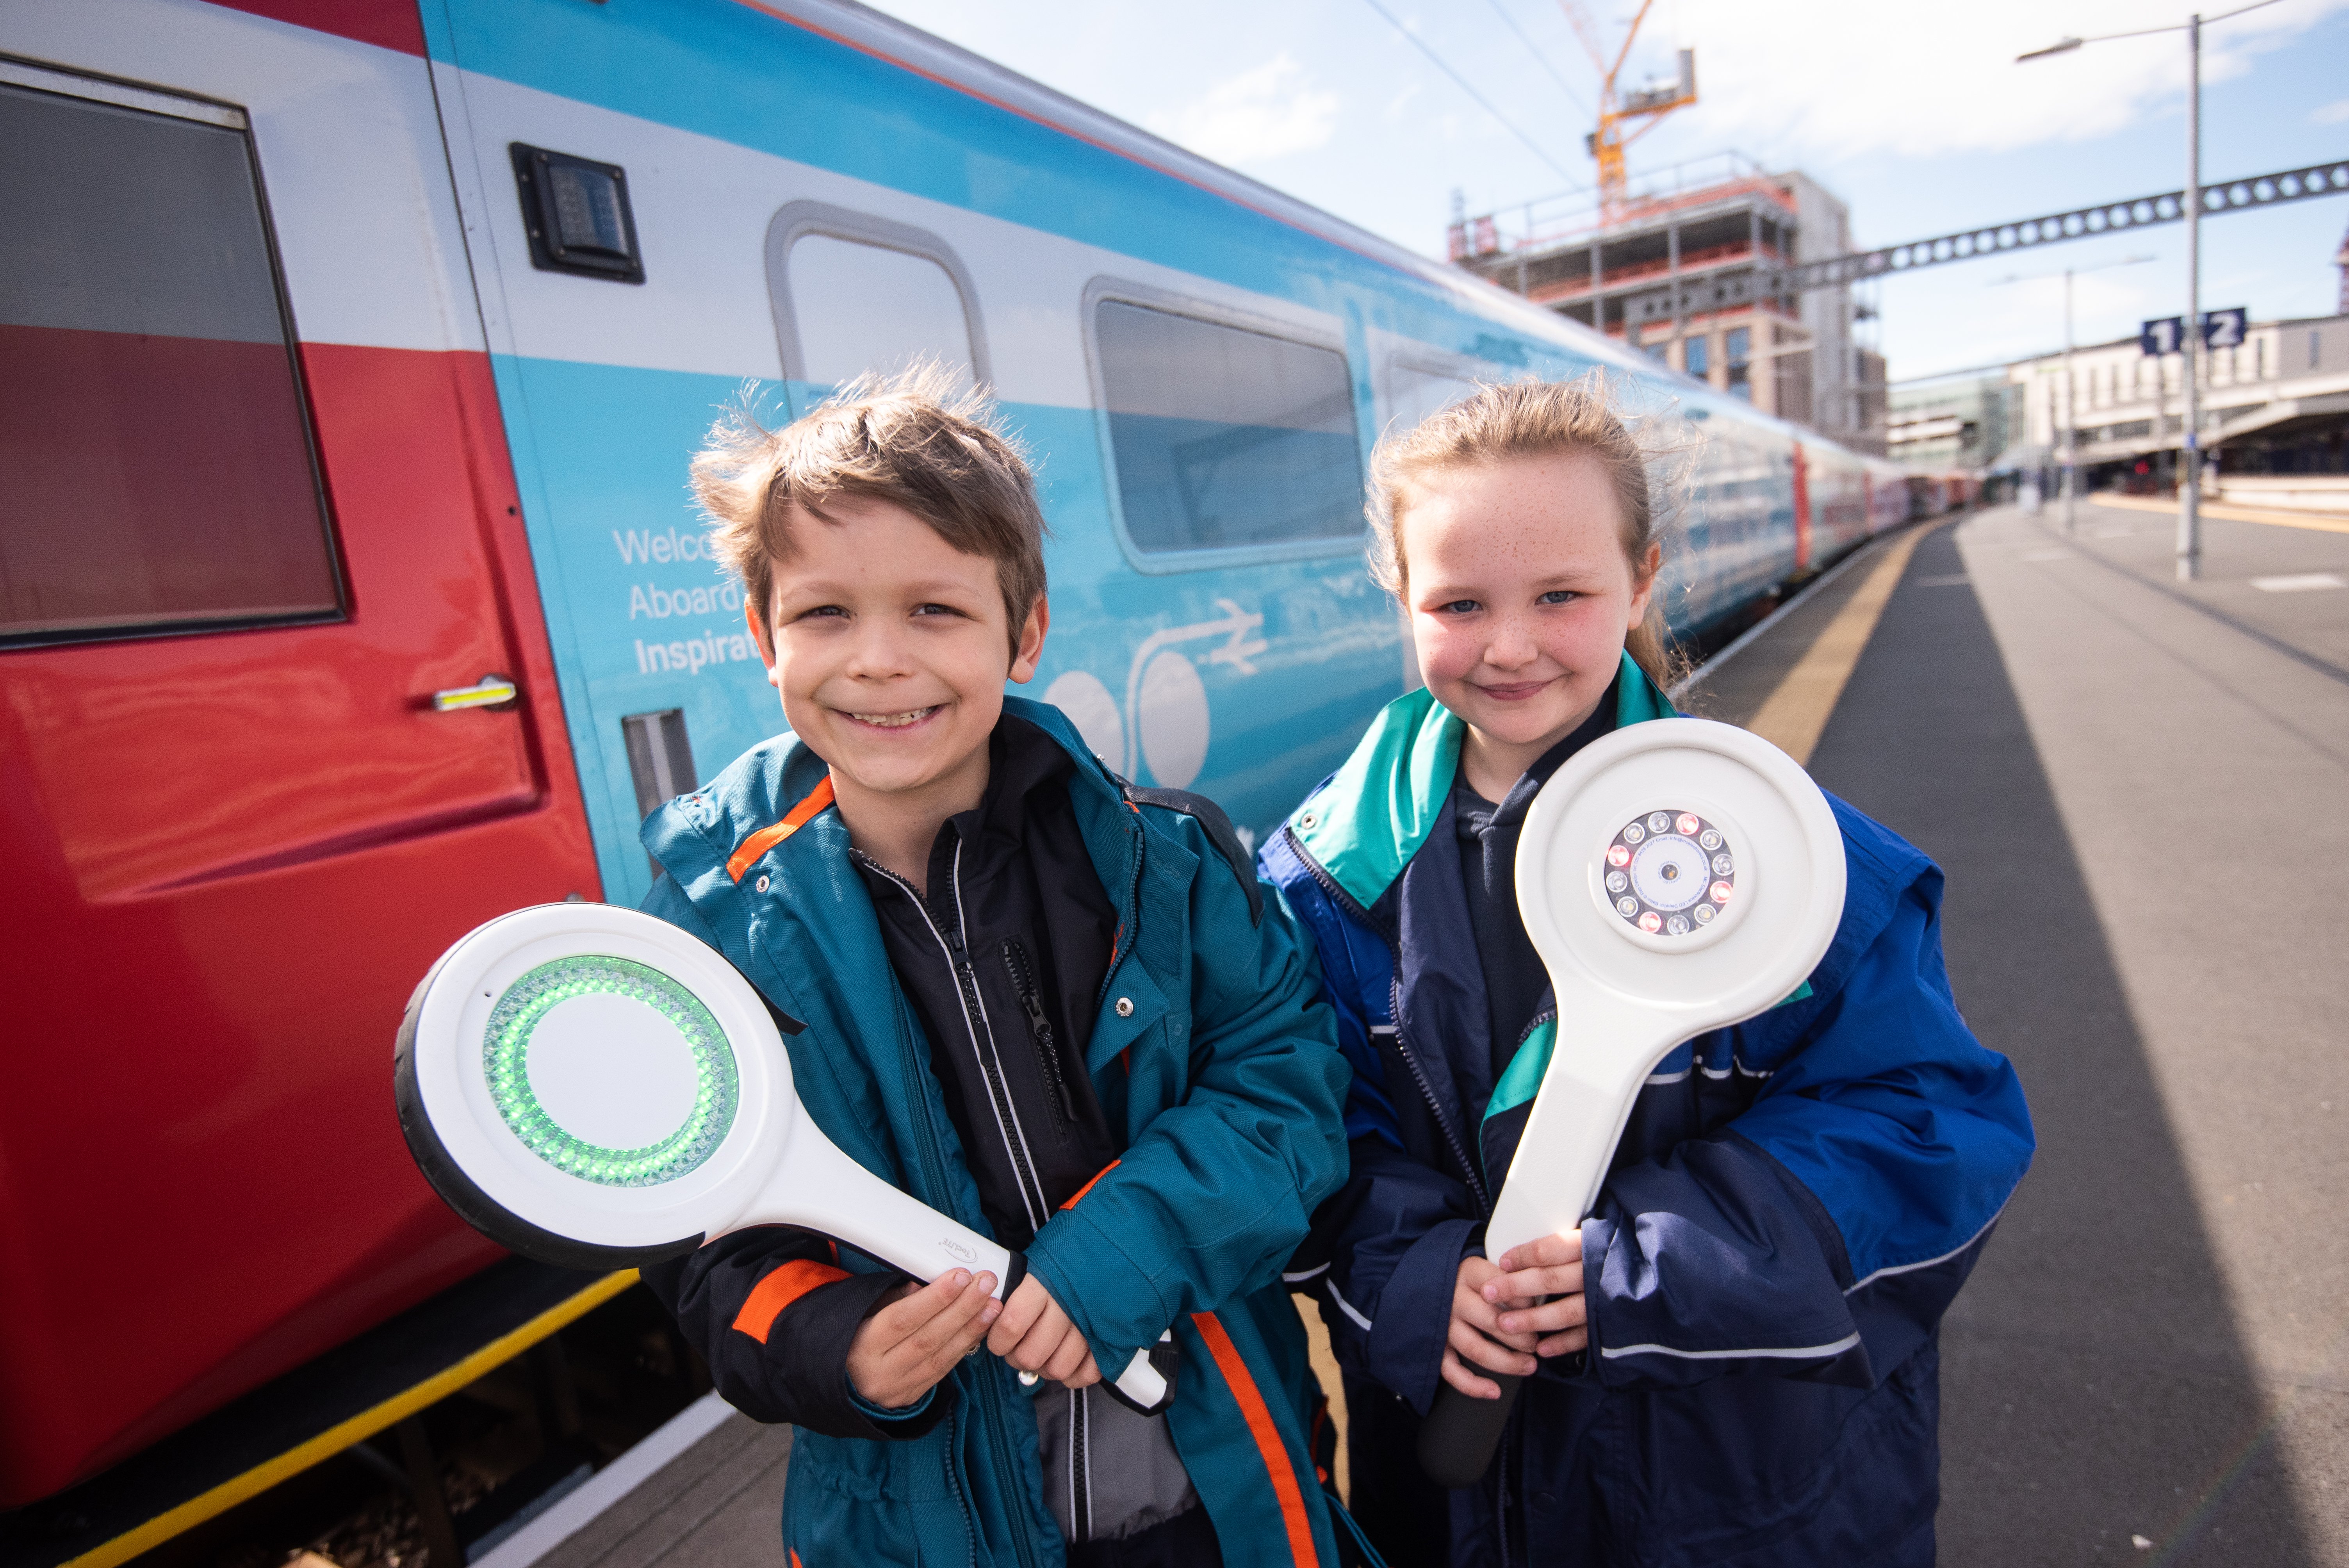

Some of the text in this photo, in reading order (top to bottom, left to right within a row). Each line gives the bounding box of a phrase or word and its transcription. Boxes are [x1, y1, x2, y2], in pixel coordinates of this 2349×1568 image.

[2148, 311, 2240, 353] 1 2
[613, 527, 715, 565] Welco
[629, 582, 740, 620] Aboard
[635, 629, 761, 675] Inspirat
